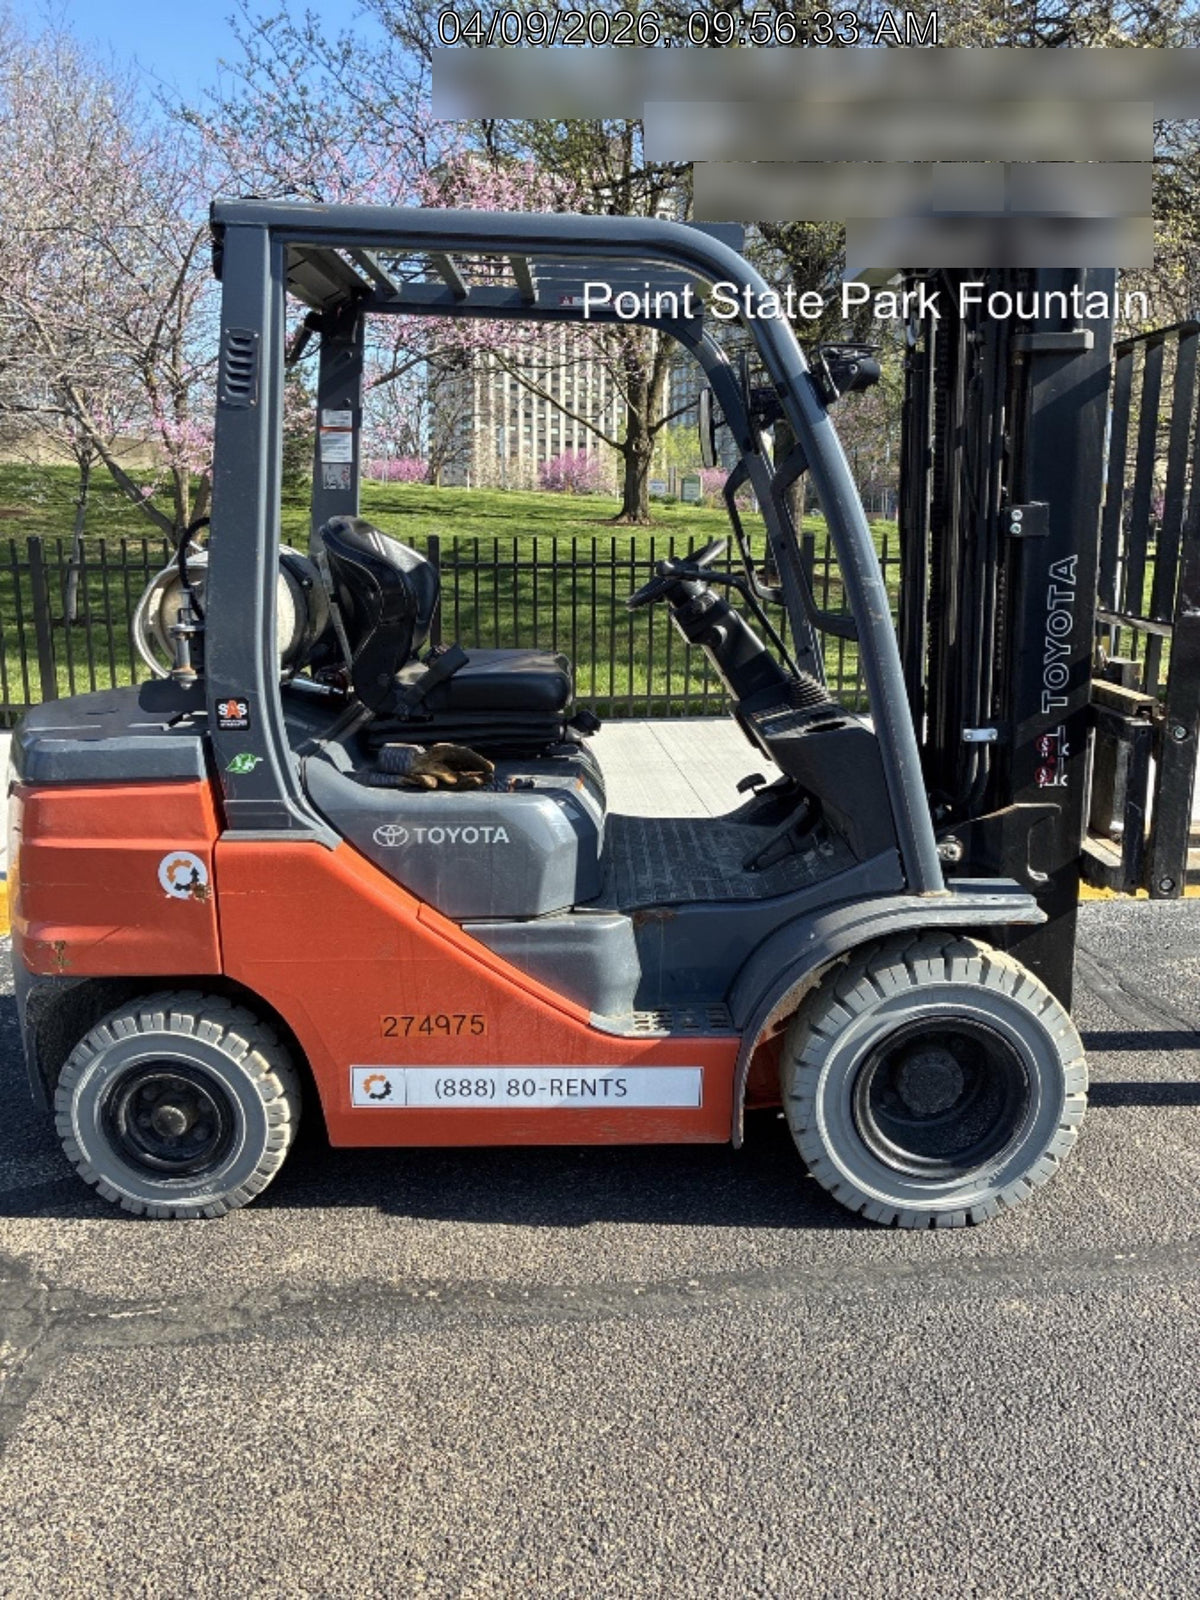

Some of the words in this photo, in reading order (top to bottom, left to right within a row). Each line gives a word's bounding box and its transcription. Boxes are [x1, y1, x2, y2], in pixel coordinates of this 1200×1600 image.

[1041, 554, 1079, 714] TOYOTA
[218, 700, 248, 719] SAS
[413, 826, 510, 844] TOYOTA
[383, 1014, 485, 1037] 274975
[434, 1078, 496, 1099] (888)
[506, 1078, 628, 1098] 80-RENTS
